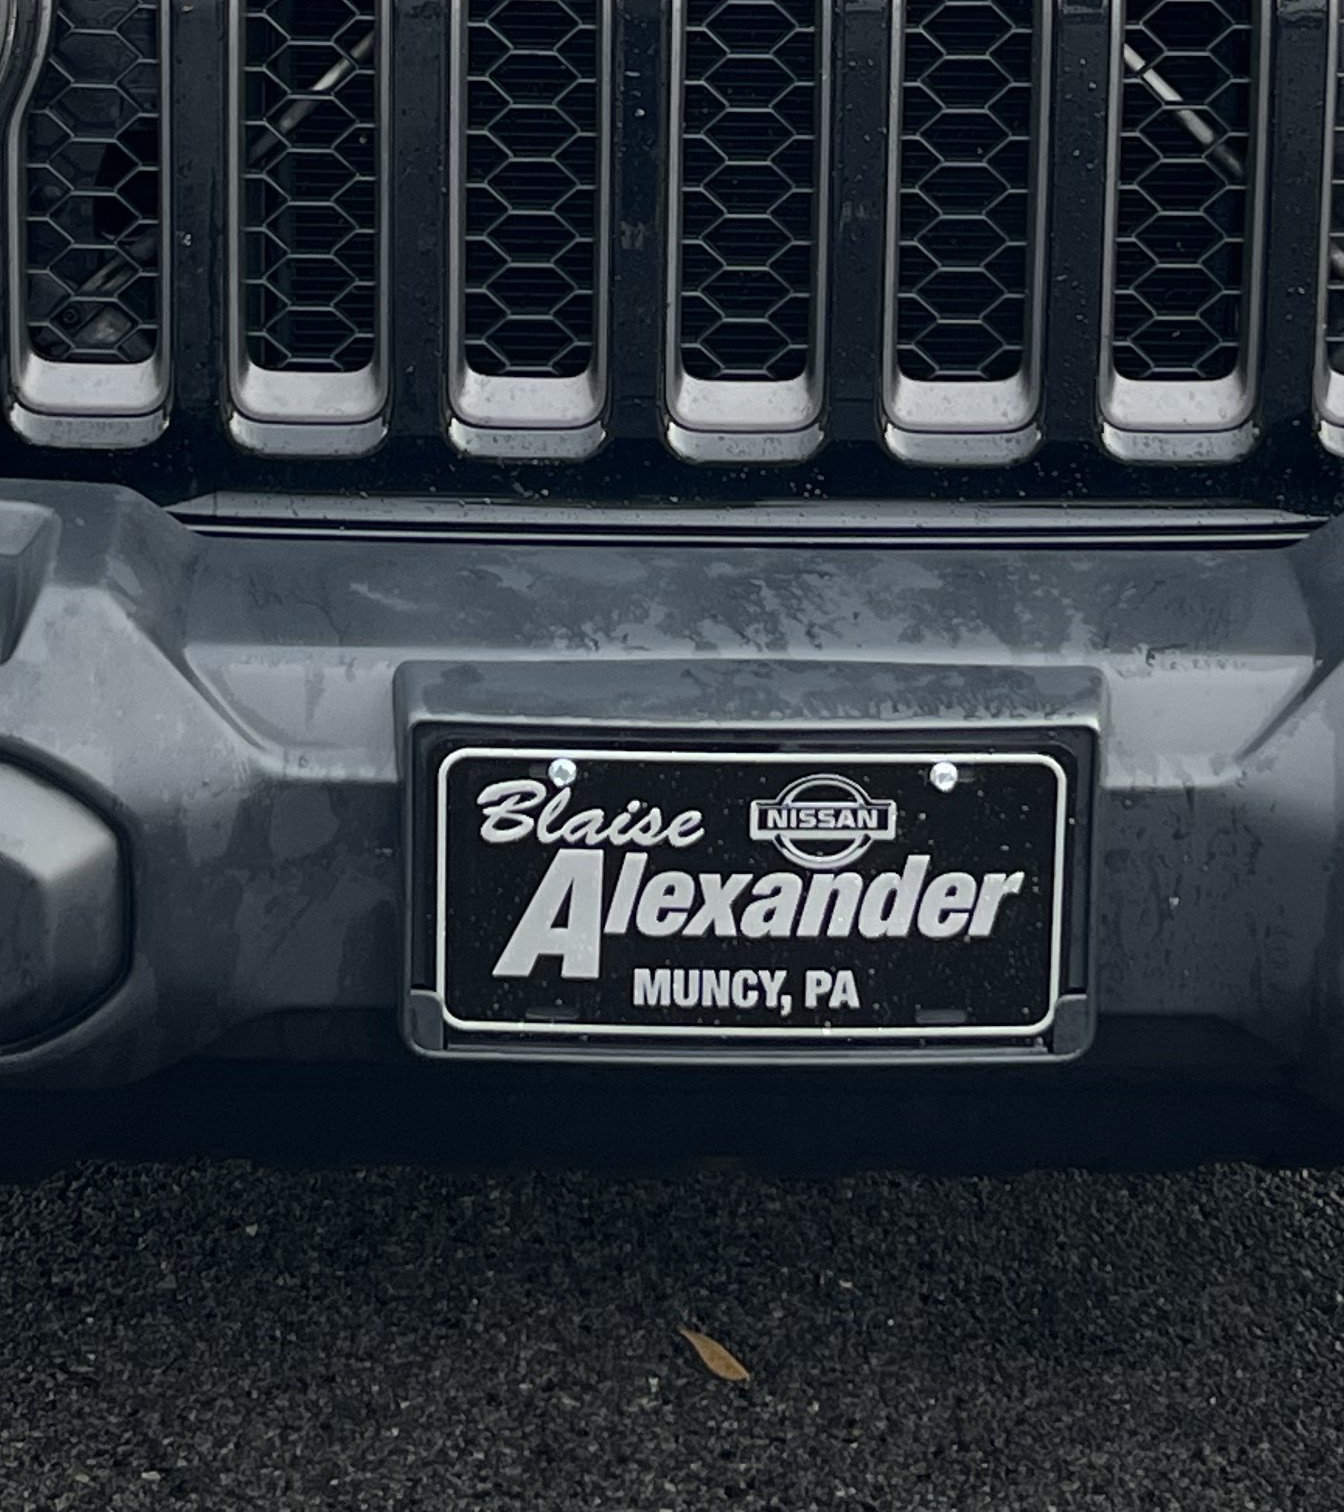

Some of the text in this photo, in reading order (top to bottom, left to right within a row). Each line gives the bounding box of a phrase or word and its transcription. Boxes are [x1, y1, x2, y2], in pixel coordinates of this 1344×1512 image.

[476, 779, 705, 847] Blaise
[765, 808, 879, 830] NISSAN
[492, 848, 1025, 979] Alexander
[632, 968, 860, 1015] MUNCY, PA
